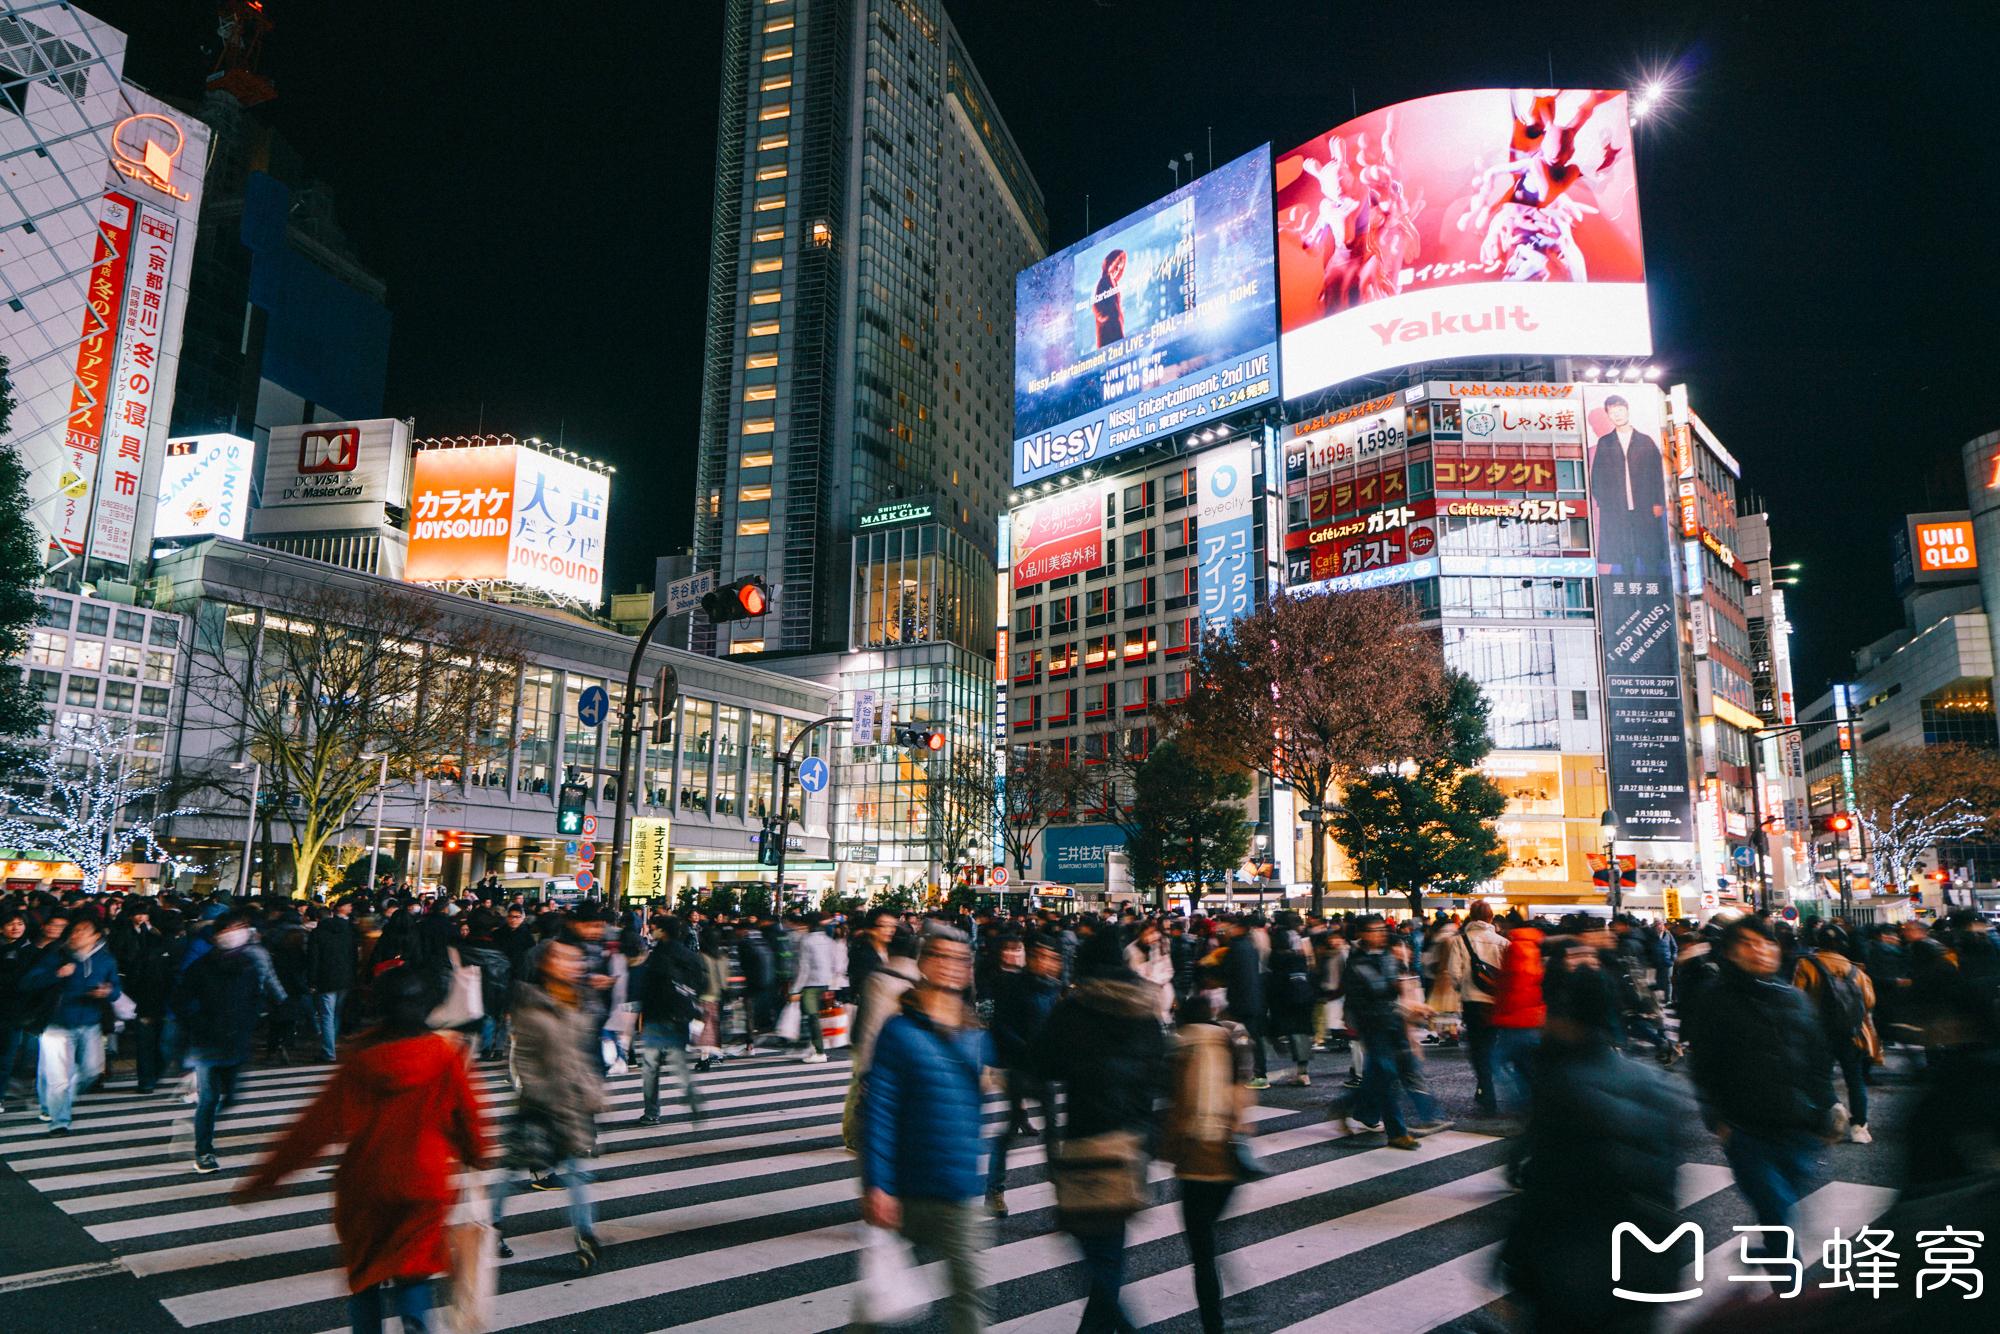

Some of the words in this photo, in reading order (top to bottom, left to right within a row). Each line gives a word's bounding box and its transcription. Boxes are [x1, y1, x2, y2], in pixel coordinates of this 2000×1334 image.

[112, 158, 191, 202] OKYU
[1028, 375, 1050, 395] Nissy
[1050, 351, 1106, 384] Entertainment
[1108, 341, 1124, 360] 2nd
[1125, 333, 1144, 353] LIVE
[1185, 311, 1194, 325] in
[1196, 293, 1227, 319] TOKYO
[1229, 279, 1258, 304] DOME
[1369, 305, 1540, 346] Yakult
[1103, 380, 1124, 401] Now
[1127, 374, 1140, 393] On
[1143, 363, 1164, 386] Sale
[1109, 406, 1136, 430] Nissy
[1138, 374, 1219, 420] Entertainment
[1221, 362, 1243, 389] 2nd
[1245, 353, 1269, 381] LIVE
[1449, 383, 1574, 398] しゃぶしゃぶバイキング
[1109, 427, 1142, 449] FINAL
[1145, 421, 1156, 435] in
[1158, 403, 1207, 431] 東京ドーム
[1210, 379, 1270, 412] 12.24発売
[1294, 393, 1396, 436] しゃぶしゃぶバイキング
[1503, 409, 1576, 431] しゃぶ葉
[65, 433, 99, 450] SALE
[1022, 419, 1104, 474] Nissy
[1357, 427, 1404, 457] 1,599円
[1288, 452, 1305, 469] 9F
[1310, 442, 1353, 471] 1,199円
[157, 447, 221, 507] SANKYO
[218, 444, 244, 526] SANKYO
[315, 474, 340, 485] VISA
[1435, 462, 1552, 485] コンタクト
[283, 488, 301, 500] DC
[302, 485, 364, 498] MasterCard
[416, 487, 510, 519] カラオケ
[519, 472, 604, 526] 大声
[1311, 471, 1404, 514] プライス
[64, 499, 75, 535] スタート
[861, 511, 897, 524] MARK
[899, 506, 930, 518] CITY
[878, 503, 912, 513] SHIBUYA
[1051, 497, 1097, 521] 品川スキン
[1204, 497, 1245, 518] eyecity
[1448, 502, 1517, 517] Caféレストラン
[1520, 500, 1576, 521] ガスト
[413, 518, 509, 540] JOYSOUND
[1051, 512, 1092, 535] クリニック
[1309, 522, 1366, 544] Caféレストラン
[1367, 506, 1416, 534] ガスト
[1922, 527, 1963, 547] UNI
[515, 516, 600, 562] だそうぜ
[1411, 538, 1433, 549] ガスト
[512, 546, 598, 585] JOYSOUND
[1025, 544, 1097, 579] 品川美容外科
[1290, 560, 1310, 578] 7F
[1315, 553, 1340, 569] Café
[1342, 539, 1401, 574] ガスト
[1489, 559, 1593, 574] 英会話イーオン
[1925, 546, 1970, 567] QLO
[670, 575, 710, 602] 渋谷駅前
[1612, 582, 1660, 595] 星野源
[676, 599, 694, 610] Shibuya
[1629, 646, 1646, 664] NOW
[1643, 637, 1656, 650] ON
[1652, 619, 1672, 640] SALE!
[1611, 679, 1633, 687] DOME
[1635, 679, 1655, 687] TOUR
[1657, 679, 1675, 687] 2019
[861, 694, 873, 740] 渋谷駅前
[633, 820, 648, 876] の再臨は近い
[651, 826, 666, 899] 主イエス・キリスト
